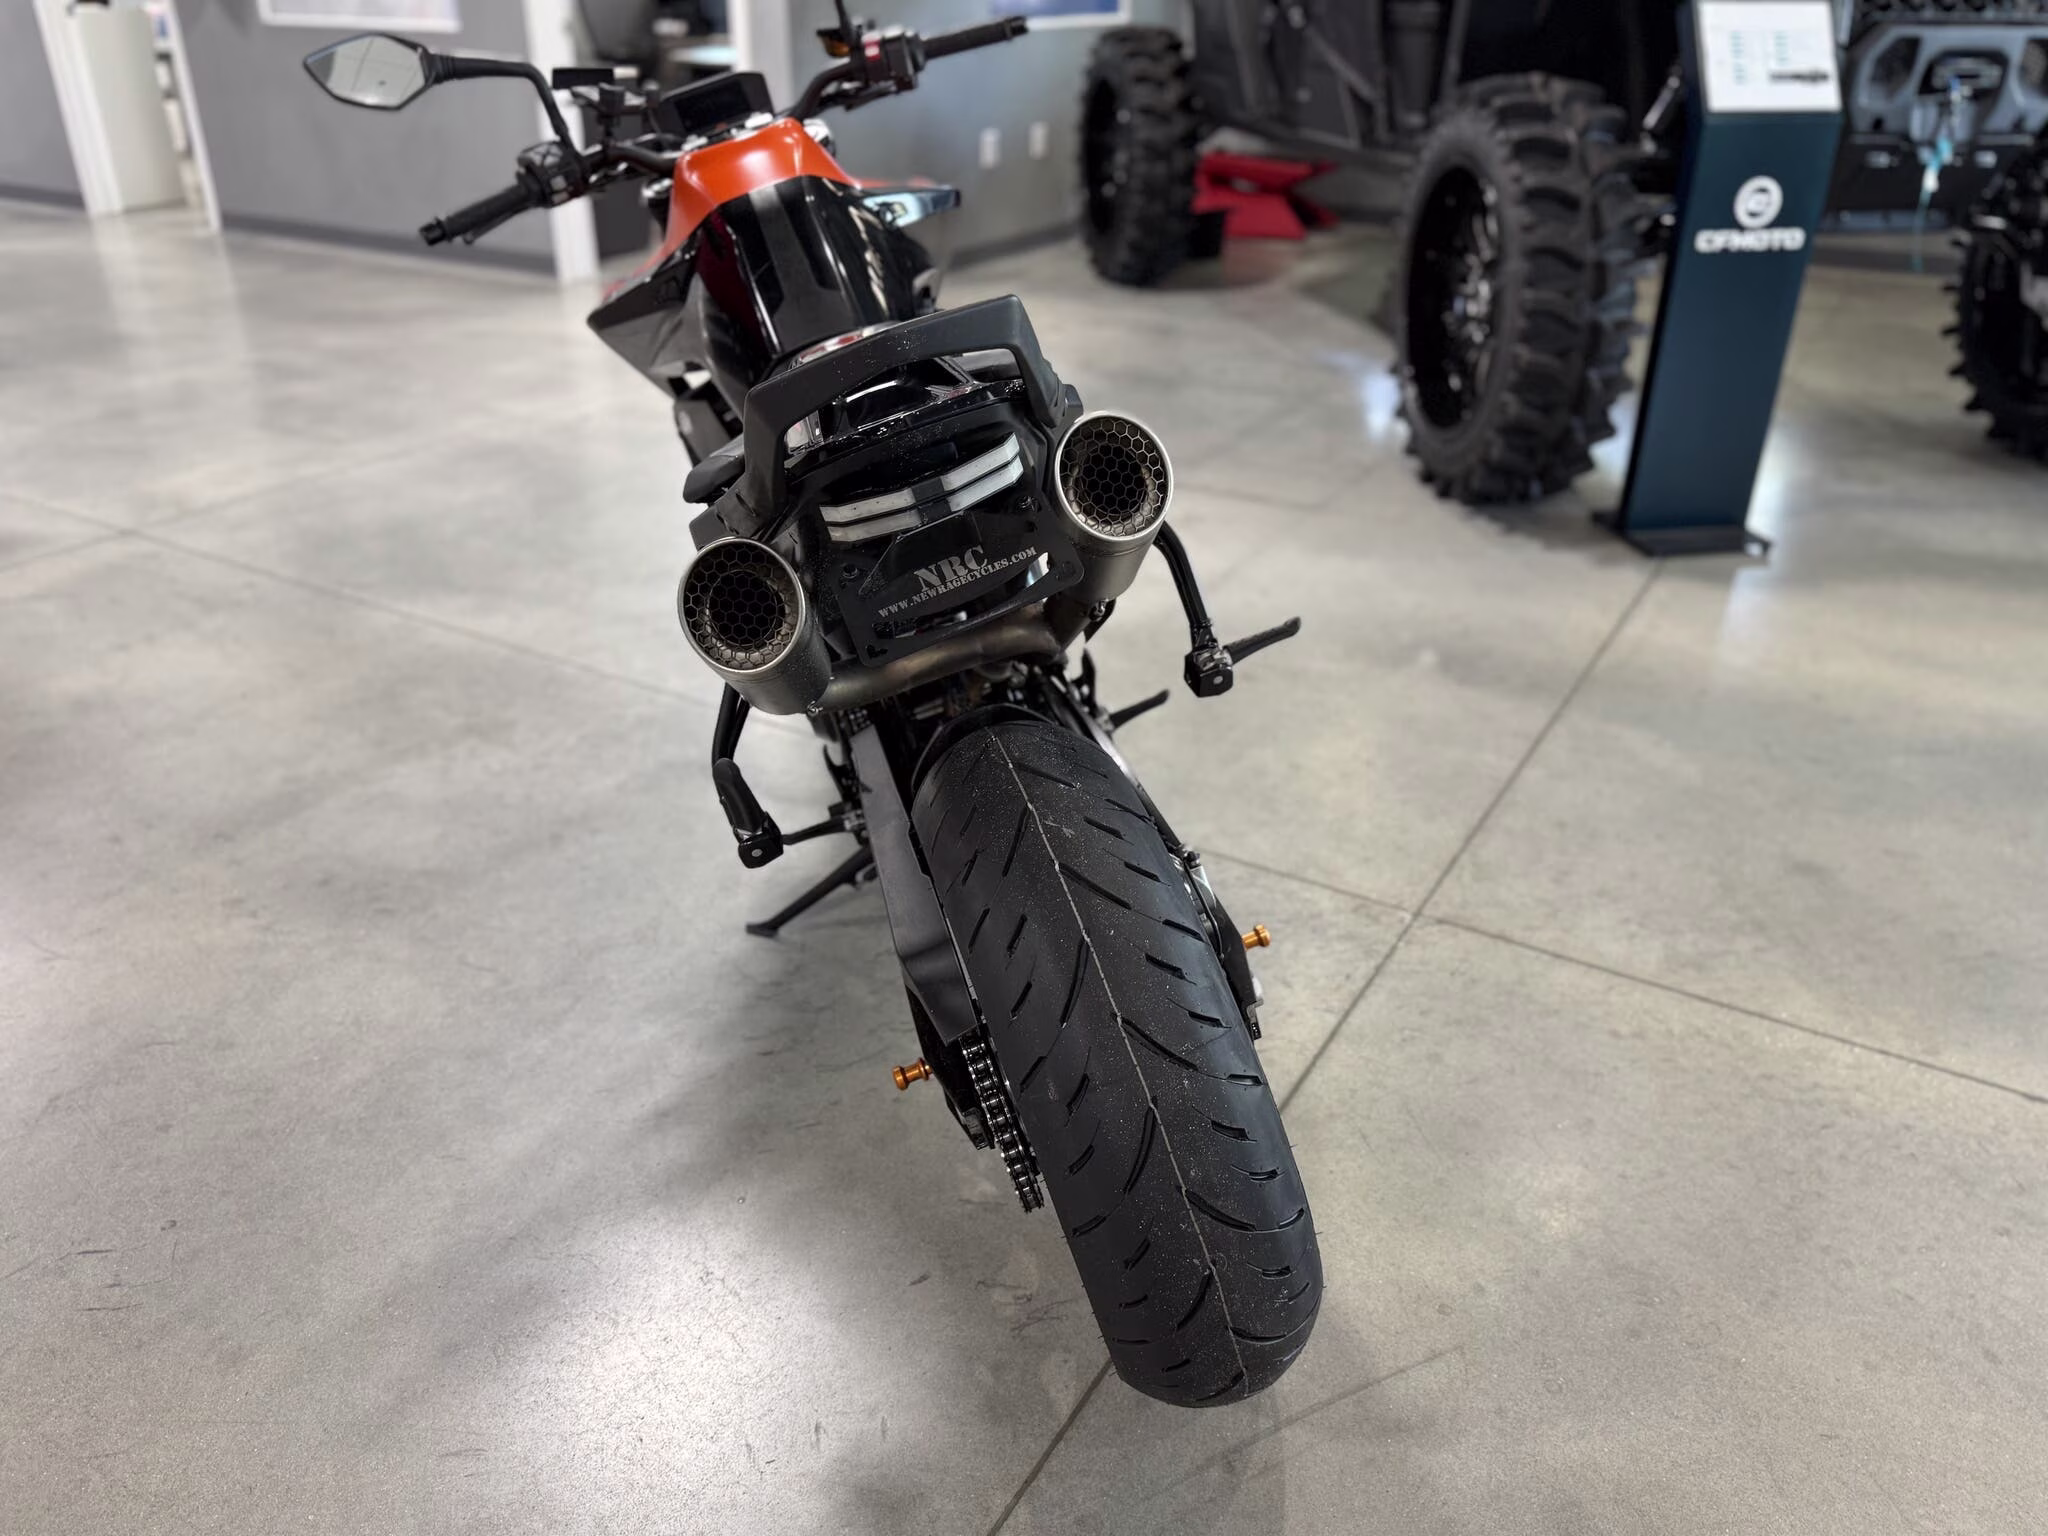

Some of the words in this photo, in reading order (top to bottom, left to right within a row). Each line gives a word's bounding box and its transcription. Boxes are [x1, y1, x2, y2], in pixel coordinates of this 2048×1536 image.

[1695, 227, 1806, 253] CFMOTO
[878, 547, 1037, 618] WWW.NEWRAGECYCLES.COM
[914, 545, 988, 591] NRC
